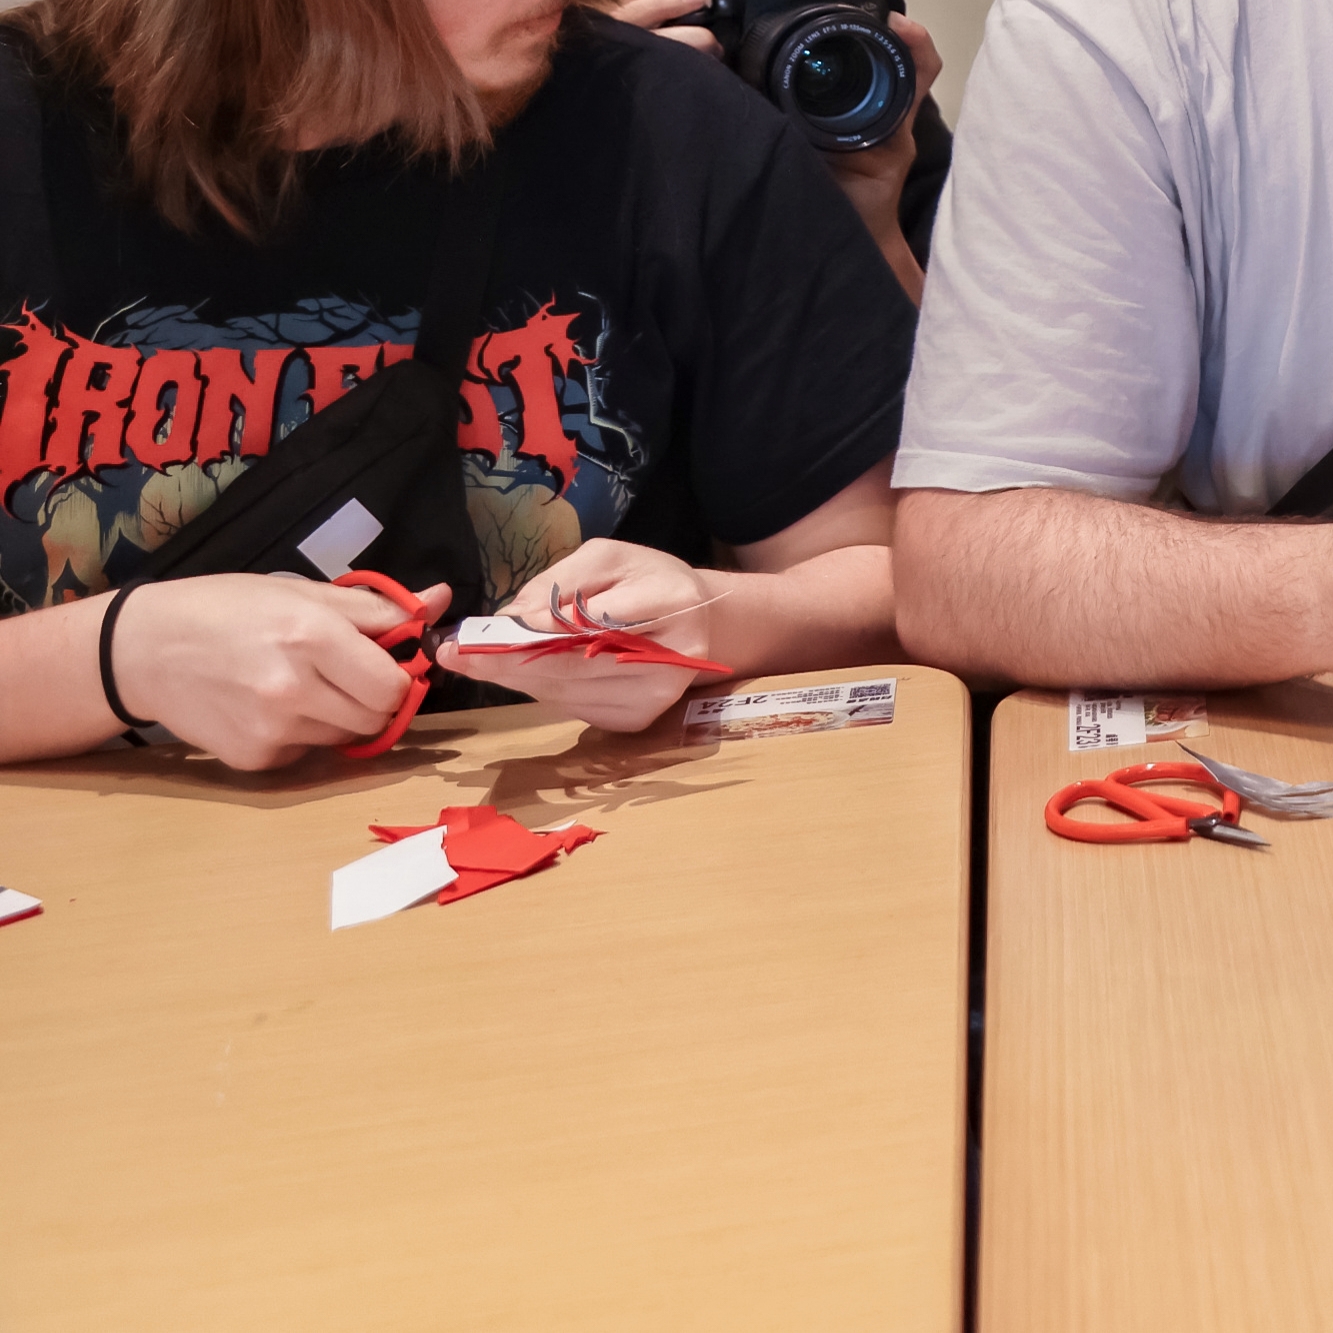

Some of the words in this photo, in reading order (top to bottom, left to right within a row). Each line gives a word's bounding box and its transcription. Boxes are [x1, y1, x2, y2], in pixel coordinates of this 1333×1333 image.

[783, 64, 793, 89] CANON
[789, 42, 805, 62] ZOOM
[804, 30, 821, 44] LENS
[0, 298, 298, 523] IRON
[702, 694, 768, 710] 2F24
